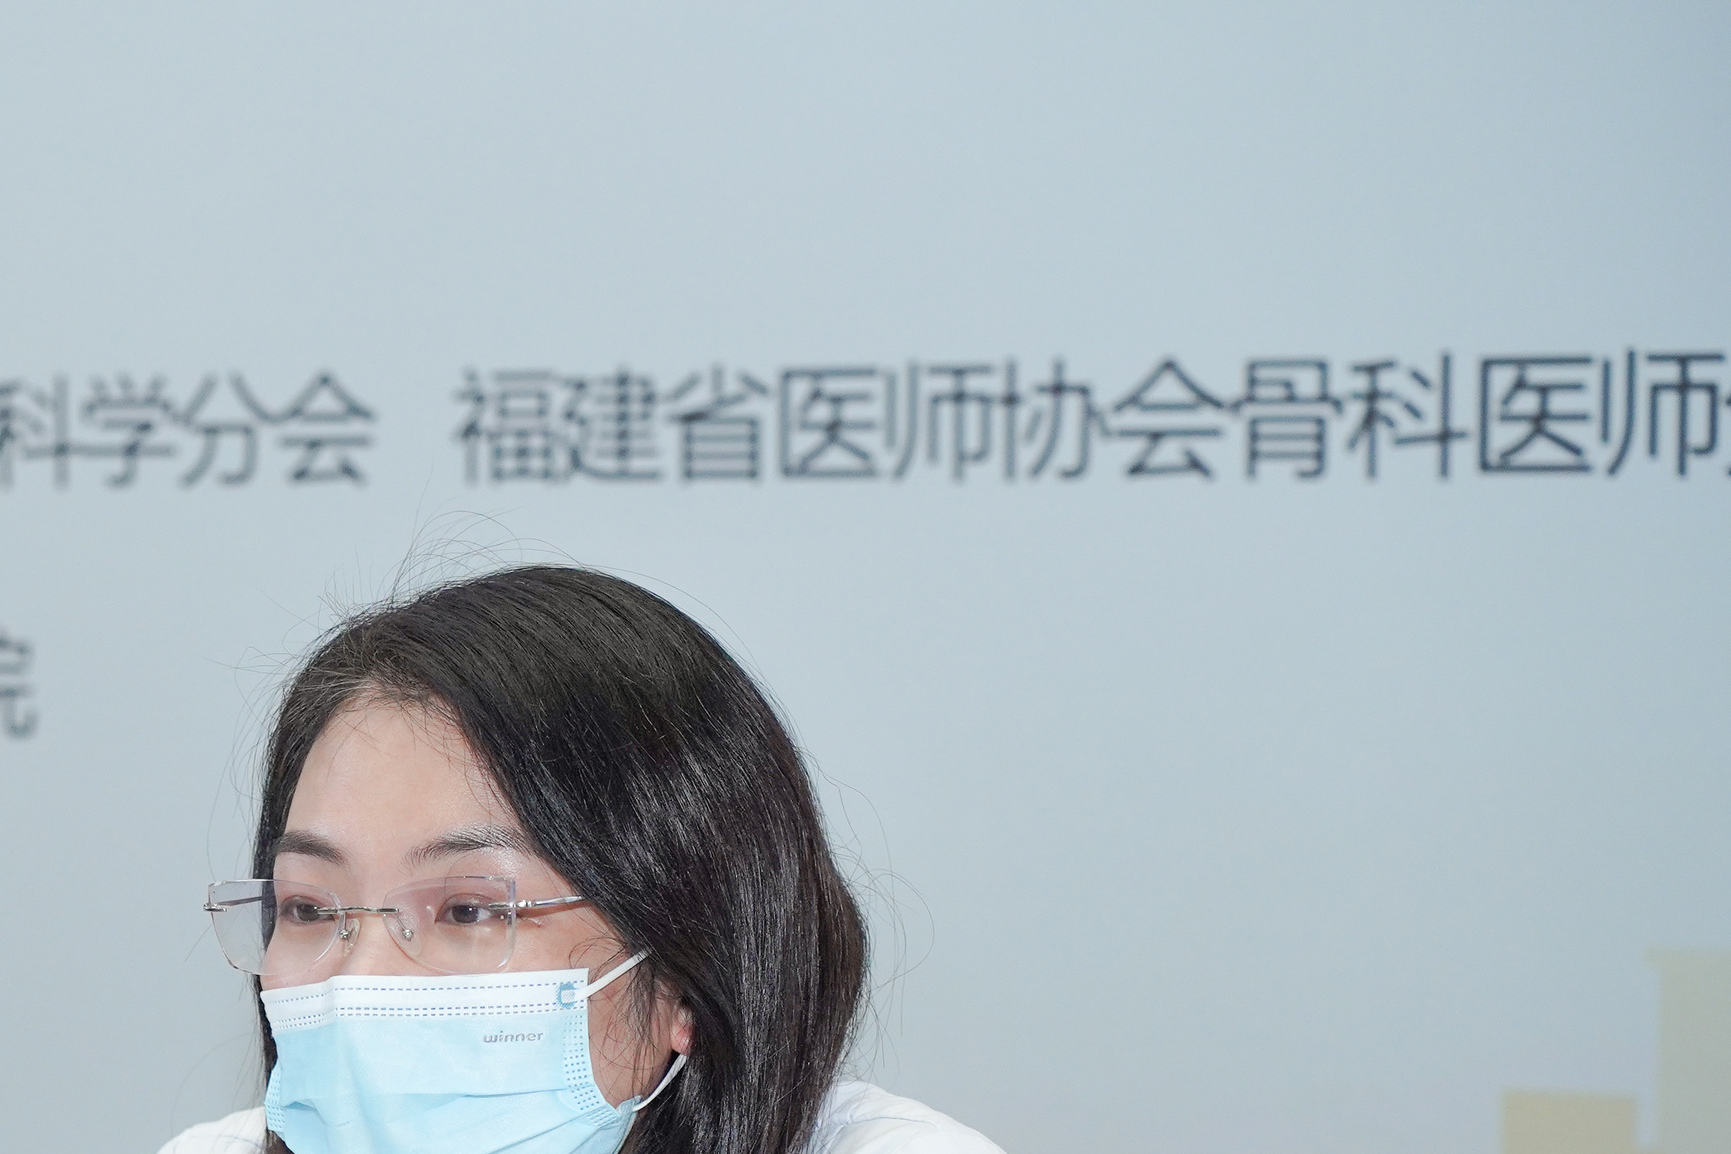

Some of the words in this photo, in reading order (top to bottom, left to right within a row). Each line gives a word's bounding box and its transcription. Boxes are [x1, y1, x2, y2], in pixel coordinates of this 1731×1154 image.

[450, 347, 1731, 485] 福建省医师协会骨科医师
[484, 1031, 543, 1043] winner
